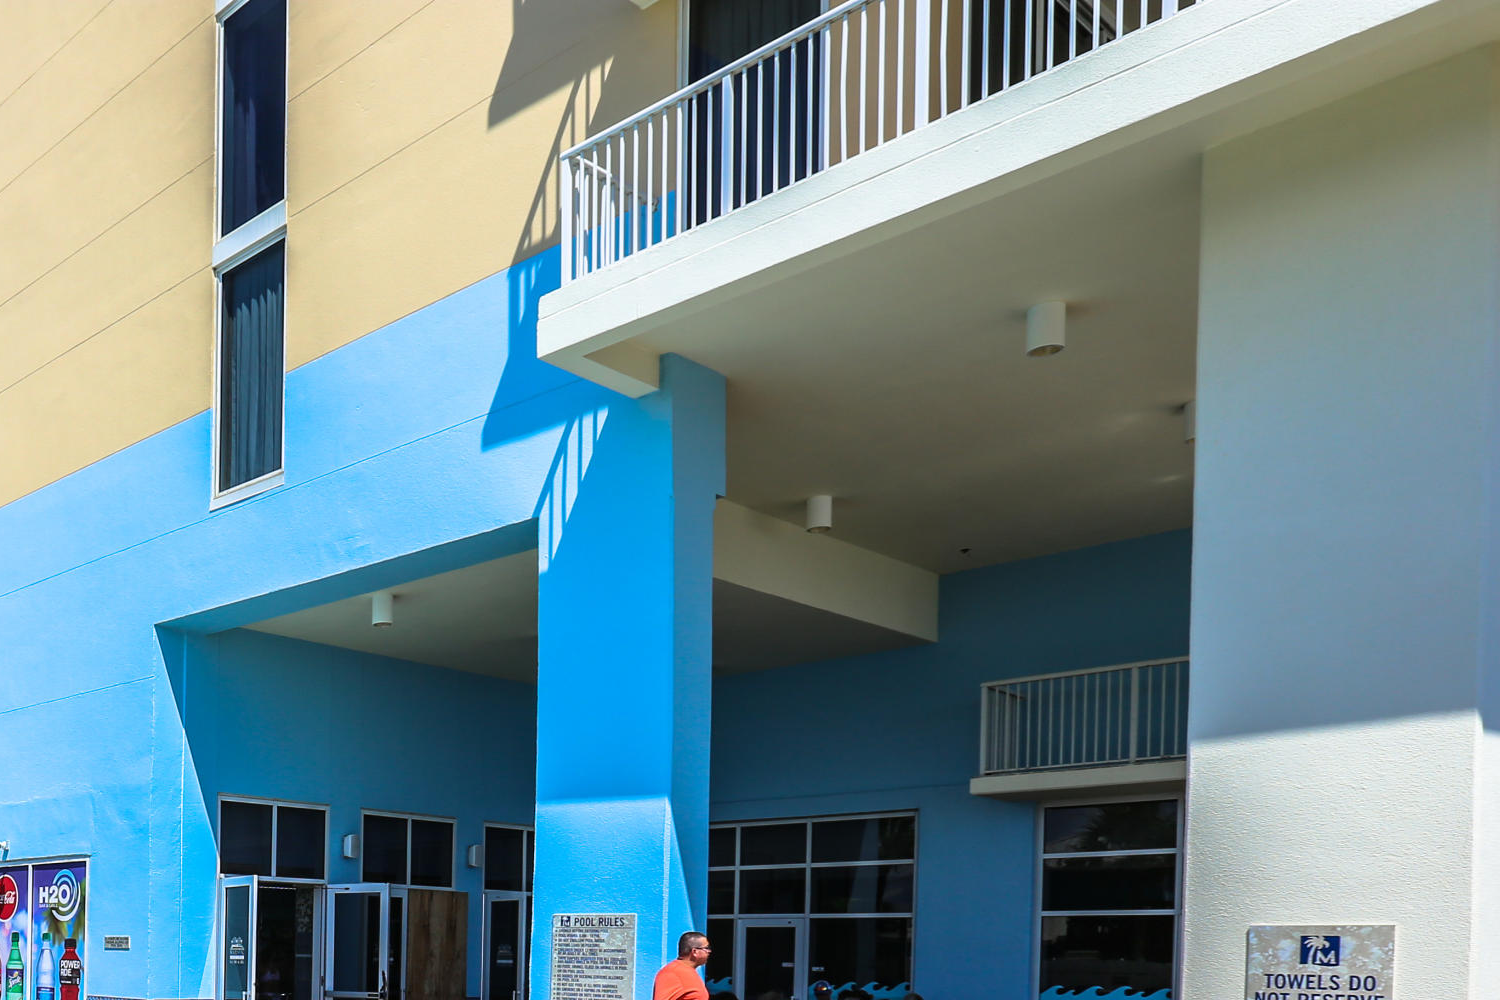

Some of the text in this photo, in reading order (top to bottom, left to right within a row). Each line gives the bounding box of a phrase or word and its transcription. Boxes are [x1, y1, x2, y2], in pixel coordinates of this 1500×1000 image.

[38, 884, 71, 904] H2O
[574, 917, 625, 927] POOL RULES
[60, 960, 80, 969] POWER
[1264, 973, 1377, 992] TOWELS DO
